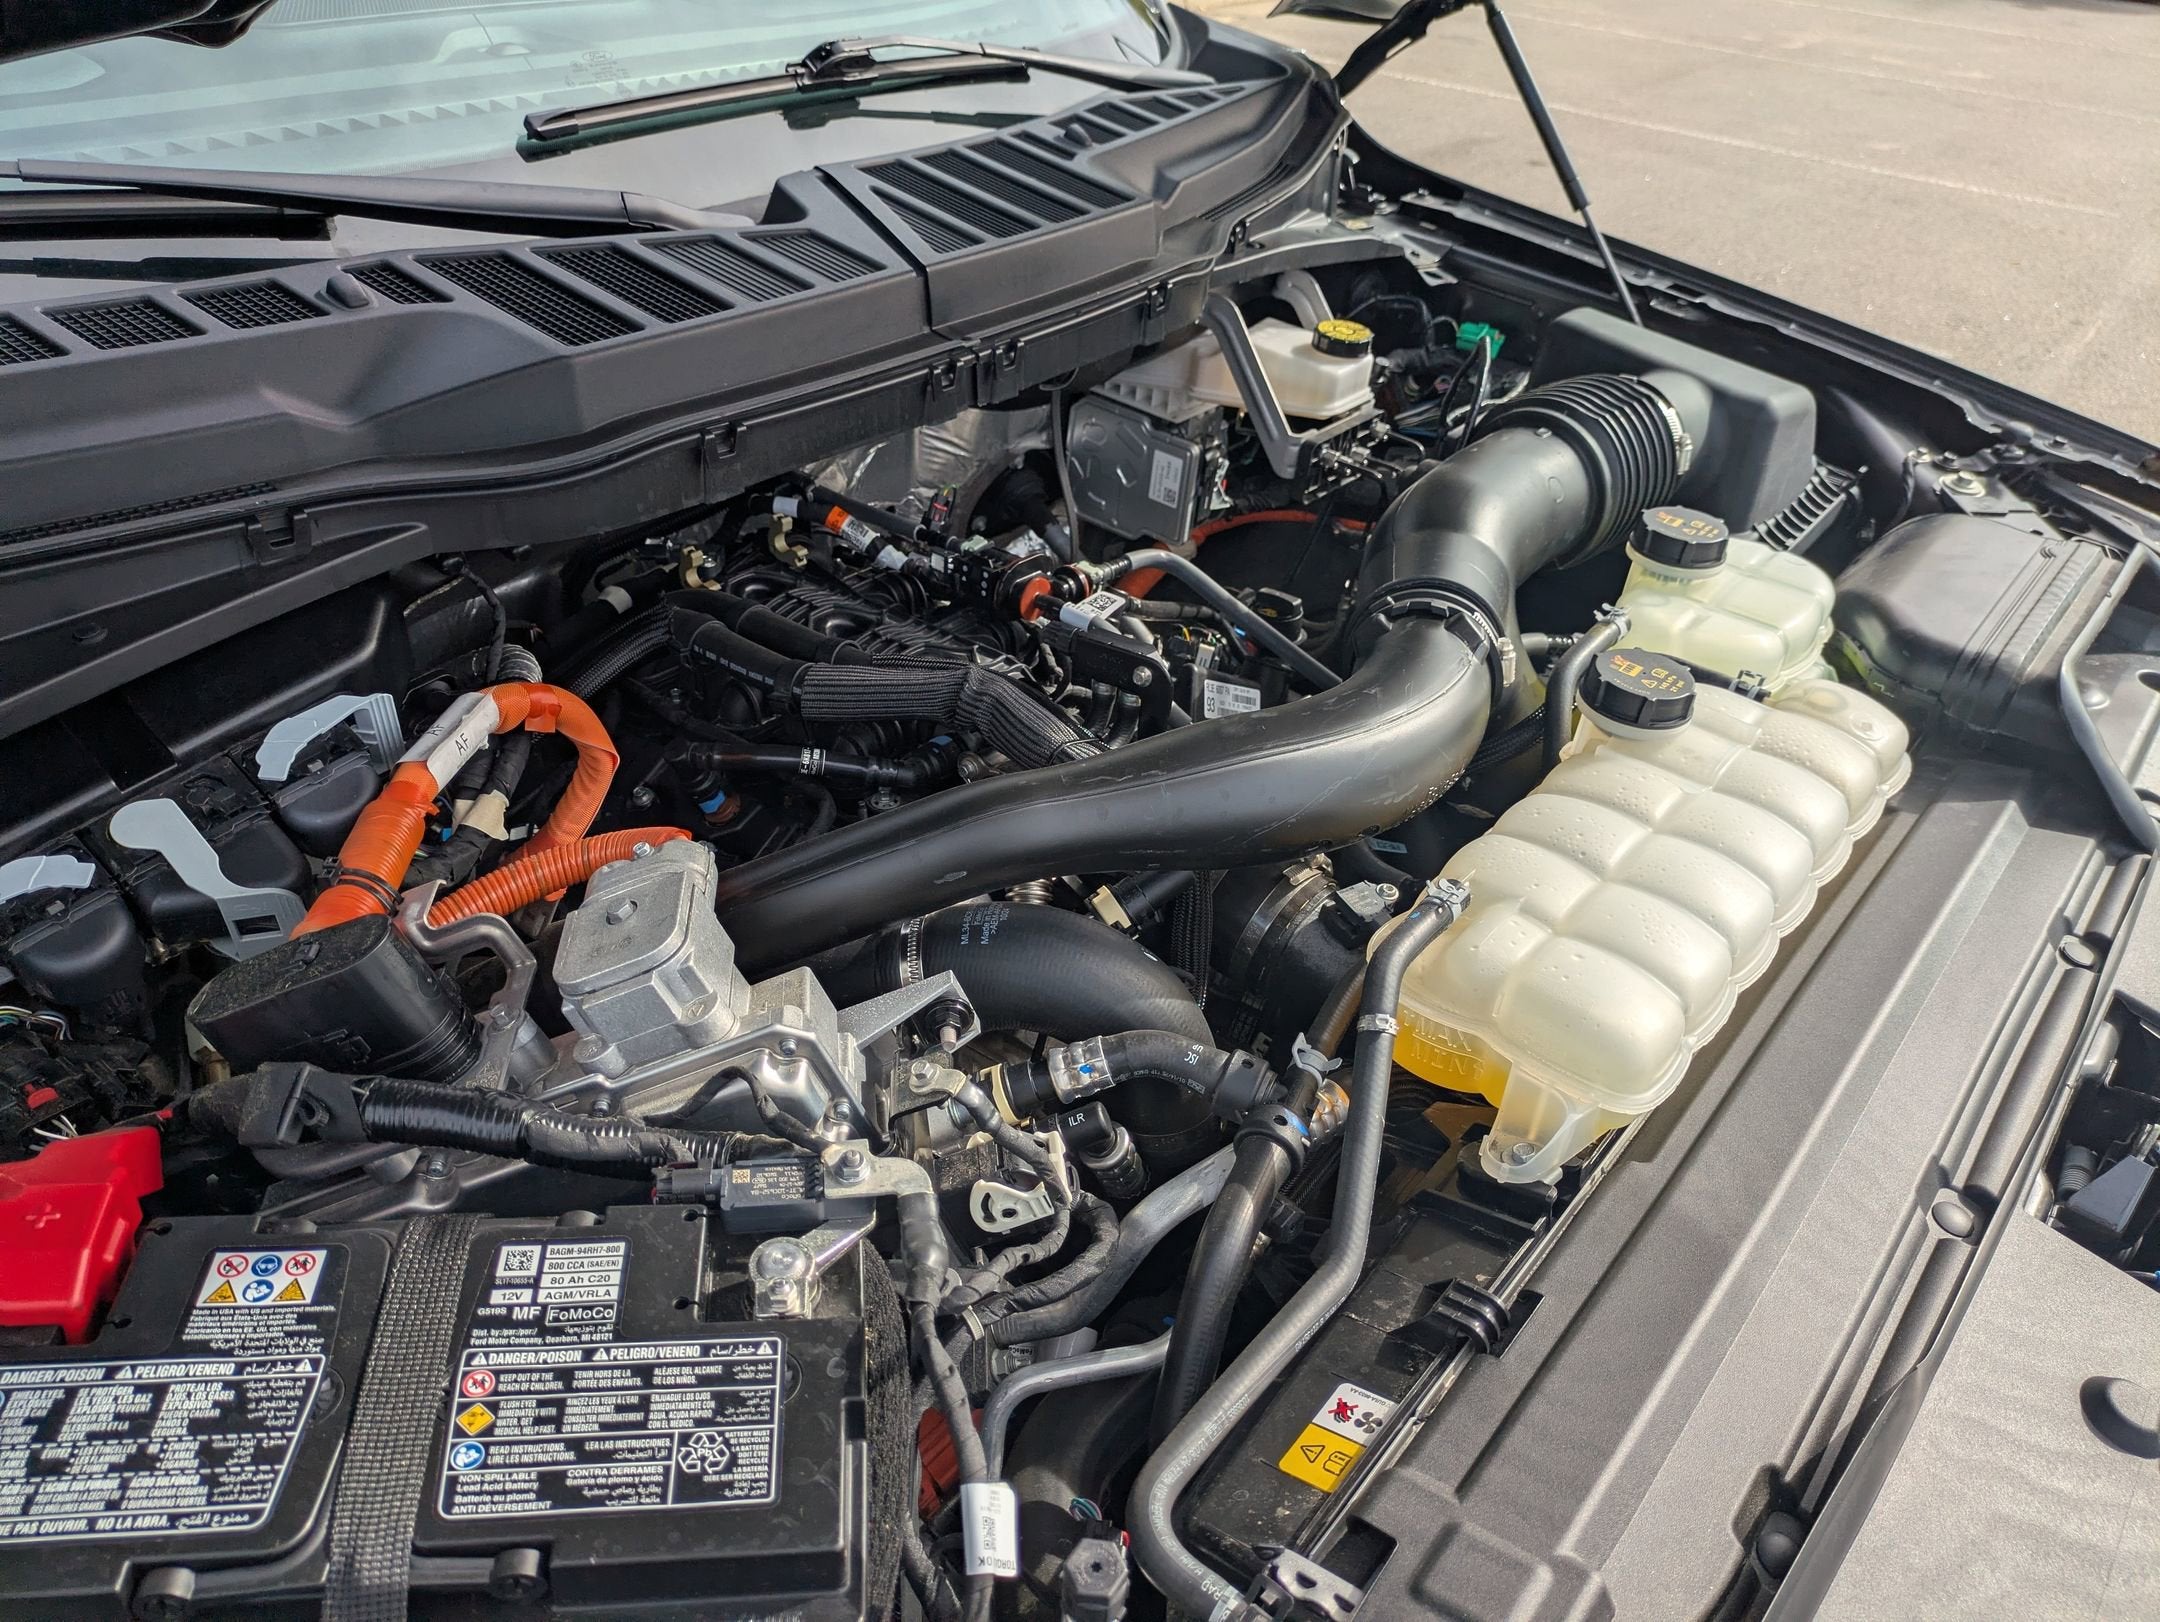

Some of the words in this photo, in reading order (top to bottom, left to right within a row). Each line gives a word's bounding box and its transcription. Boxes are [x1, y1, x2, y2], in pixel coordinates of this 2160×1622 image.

[454, 732, 470, 756] AF
[1192, 1043, 1204, 1053] UP
[1184, 1051, 1199, 1066] ISC
[1068, 1112, 1086, 1127] ILR
[549, 1245, 621, 1256] BAGM-94RH7-800
[548, 1262, 565, 1271] 800
[567, 1261, 585, 1270] CCA
[587, 1259, 620, 1268] (SAE/EN)
[550, 1277, 565, 1285] 80
[568, 1275, 584, 1285] Ah
[588, 1274, 611, 1283] C20
[501, 1291, 524, 1301] 12V
[544, 1291, 612, 1301] AGM/VRLA
[235, 1307, 250, 1315] with
[250, 1307, 261, 1315] US
[274, 1306, 304, 1315] imported
[511, 1306, 542, 1321] MF
[549, 1306, 614, 1321] FoMoCo
[471, 1328, 490, 1337] Dist.
[470, 1337, 487, 1346] Ford
[488, 1337, 509, 1345] Motor
[510, 1336, 545, 1345] Company,
[545, 1335, 580, 1344] Dearborn,
[581, 1334, 592, 1342] MI
[591, 1333, 613, 1342] 48121
[609, 1345, 701, 1361] PELIGRO/VENENO
[709, 1344, 756, 1358] خطر/سام
[488, 1350, 583, 1365] DANGER/POISON
[134, 1362, 236, 1379] PELIGRO/VENENO
[243, 1361, 295, 1377] خطر/سام
[574, 1371, 595, 1380] TENIR
[595, 1370, 612, 1379] HORS
[613, 1370, 622, 1378] DE
[622, 1369, 631, 1378] LA
[681, 1366, 693, 1375] DEL
[694, 1365, 723, 1374] ALCANCE
[0, 1367, 105, 1385] DANGER/POISON
[500, 1373, 518, 1383] KEEP
[518, 1373, 531, 1382] OUT
[531, 1372, 540, 1381] OF
[541, 1372, 554, 1381] THE
[652, 1376, 662, 1385] DE
[663, 1376, 675, 1385] LOS
[169, 1383, 206, 1393] PROTEJA
[206, 1382, 223, 1391] LOS
[498, 1383, 521, 1392] REACH
[522, 1383, 530, 1391] OF
[599, 1379, 611, 1388] DES
[190, 1391, 208, 1401] LOS
[207, 1390, 236, 1401] GASES
[682, 1392, 694, 1401] LOS
[162, 1400, 214, 1411] EXPLOSIVOS
[521, 1400, 537, 1408] EYES
[588, 1398, 600, 1406] LES
[702, 1400, 716, 1409] CON
[158, 1409, 190, 1419] PUEDEN
[189, 1408, 221, 1418] CAUSAR
[520, 1417, 533, 1426] GET
[647, 1420, 661, 1429] CON
[661, 1420, 669, 1429] EL
[522, 1426, 538, 1435] HELP
[489, 1446, 510, 1455] READ
[511, 1443, 567, 1454] INSTRUCTIONS.
[584, 1442, 599, 1451] LEA
[600, 1441, 614, 1450] LAS
[614, 1438, 672, 1449] INSTRUCCIONES.
[487, 1455, 505, 1465] LIRE
[505, 1455, 520, 1464] LES
[520, 1452, 577, 1463] INSTRUCTIONS.
[697, 1448, 713, 1458] Pb
[567, 1467, 608, 1478] CONTRA
[609, 1465, 664, 1476] DERRAMES
[458, 1472, 538, 1483] NON-SPILLABLE
[596, 1476, 607, 1485] de
[607, 1475, 634, 1486] plomo
[456, 1483, 481, 1493] Lead
[481, 1482, 504, 1492] Acid
[504, 1481, 539, 1491] Battery
[453, 1494, 492, 1504] Batterie
[492, 1494, 506, 1502] au
[506, 1492, 537, 1502] plomb
[452, 1505, 476, 1514] ANTI
[476, 1500, 553, 1513] DÉVERSEMENT
[13, 1522, 40, 1536] PAS
[39, 1518, 89, 1534] OUVRIR.
[95, 1517, 115, 1530] NO
[115, 1516, 133, 1529] LA
[134, 1515, 171, 1529] ABRA.
[978, 1556, 993, 1567] OK
[1200, 1581, 1224, 1601] RAD
